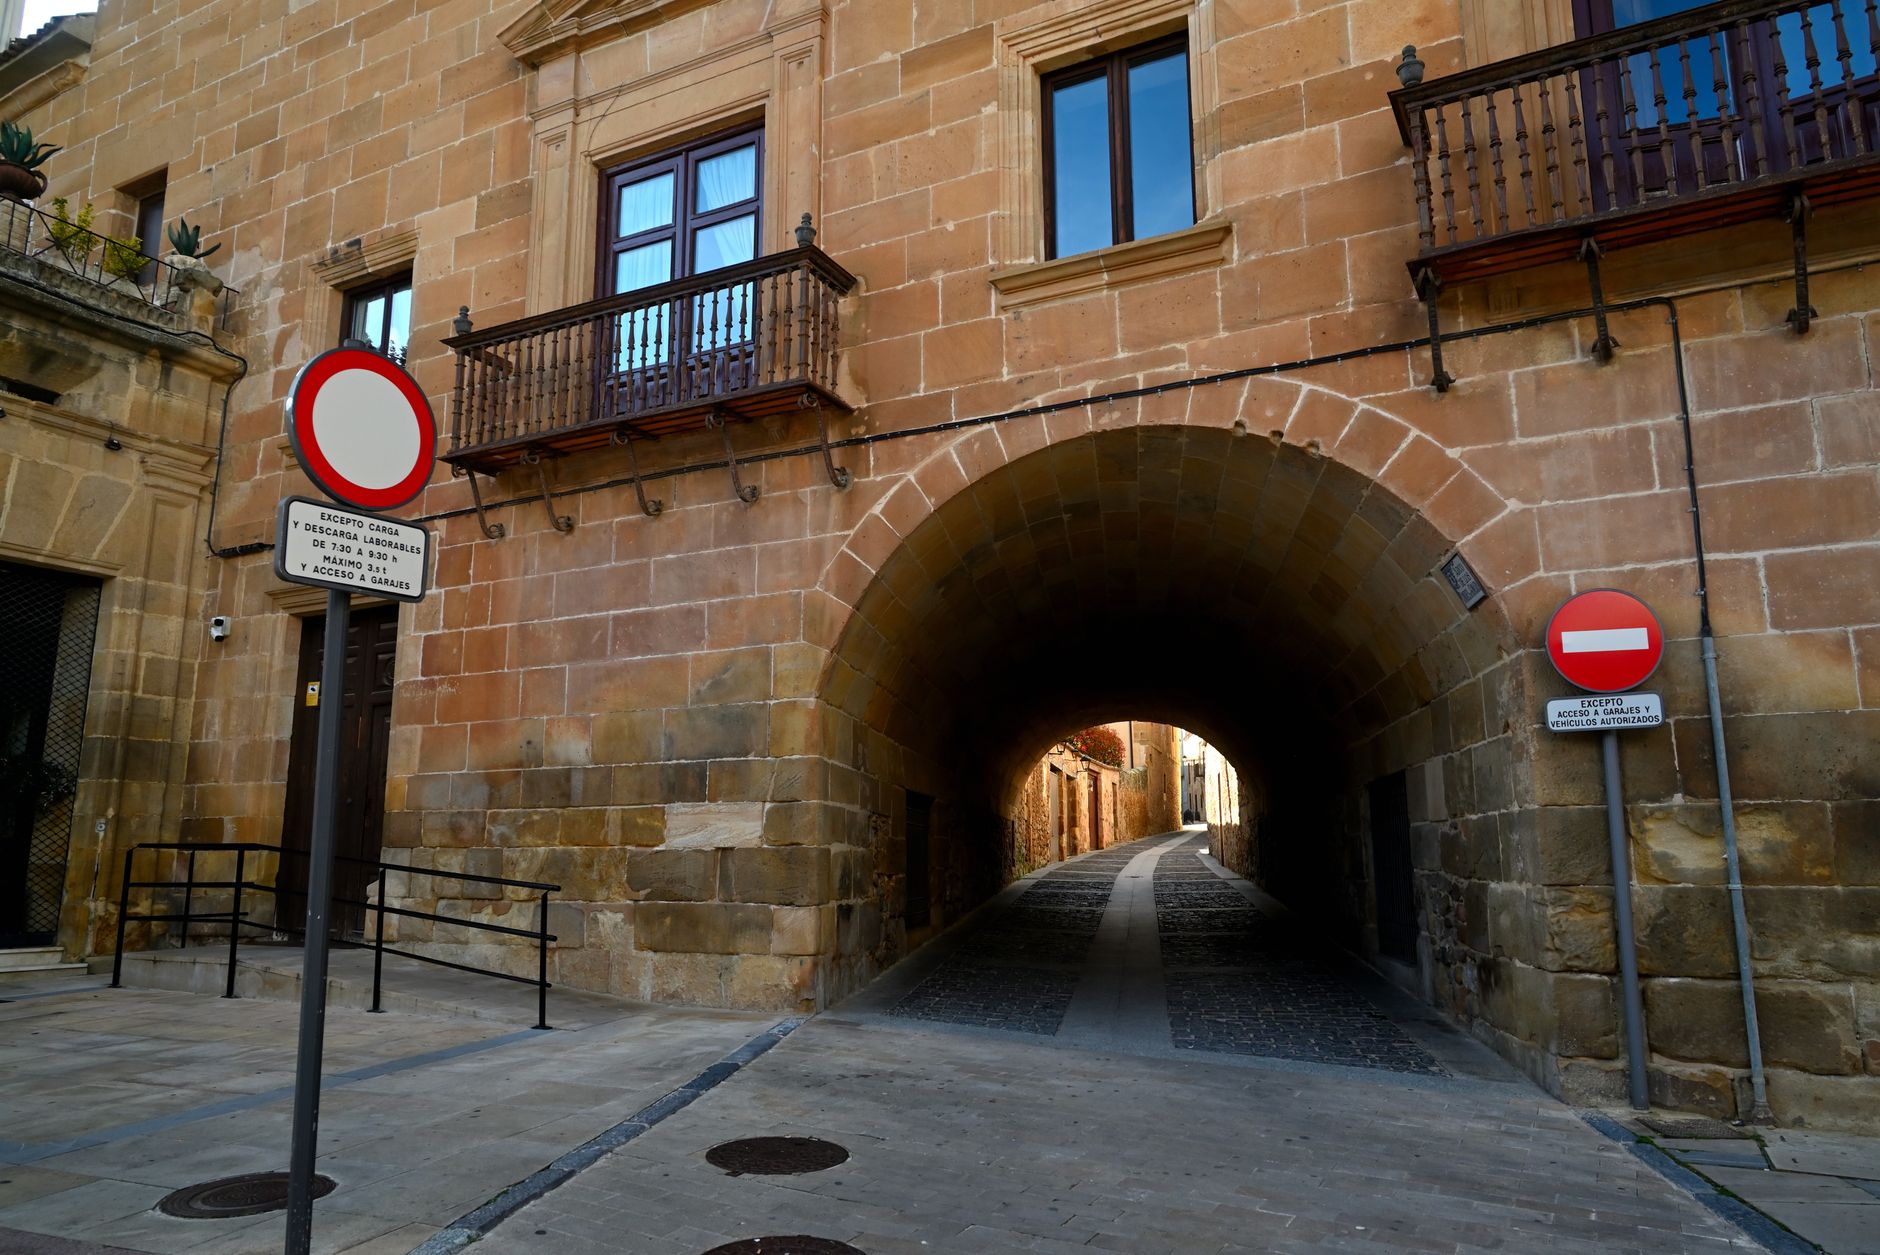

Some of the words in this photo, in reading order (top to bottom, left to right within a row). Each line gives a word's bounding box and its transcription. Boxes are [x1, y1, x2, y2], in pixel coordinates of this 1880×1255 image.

[320, 512, 363, 528] EXCEPTO
[369, 523, 399, 536] CARGA
[293, 520, 299, 529] Y
[304, 523, 359, 541] DESCARGA
[363, 535, 421, 555] LABORABLES
[312, 538, 326, 549] DE
[331, 543, 351, 554] 7:30
[356, 548, 363, 556] A
[368, 550, 388, 561] 9:30
[392, 554, 398, 563] h
[323, 554, 363, 570] MÁXIMO
[383, 567, 387, 575] t
[301, 562, 307, 571] Y
[313, 565, 354, 580] ACCESO
[359, 574, 366, 582] A
[371, 575, 410, 590] GARAJES
[1557, 709, 1590, 718] ACCESO
[1603, 706, 1641, 716] GARAJES
[1644, 705, 1650, 713] Y
[1580, 698, 1623, 709] EXCEPTO
[1550, 718, 1597, 728] VEHÍCULOS
[1600, 715, 1660, 726] AUTORIZADOS
